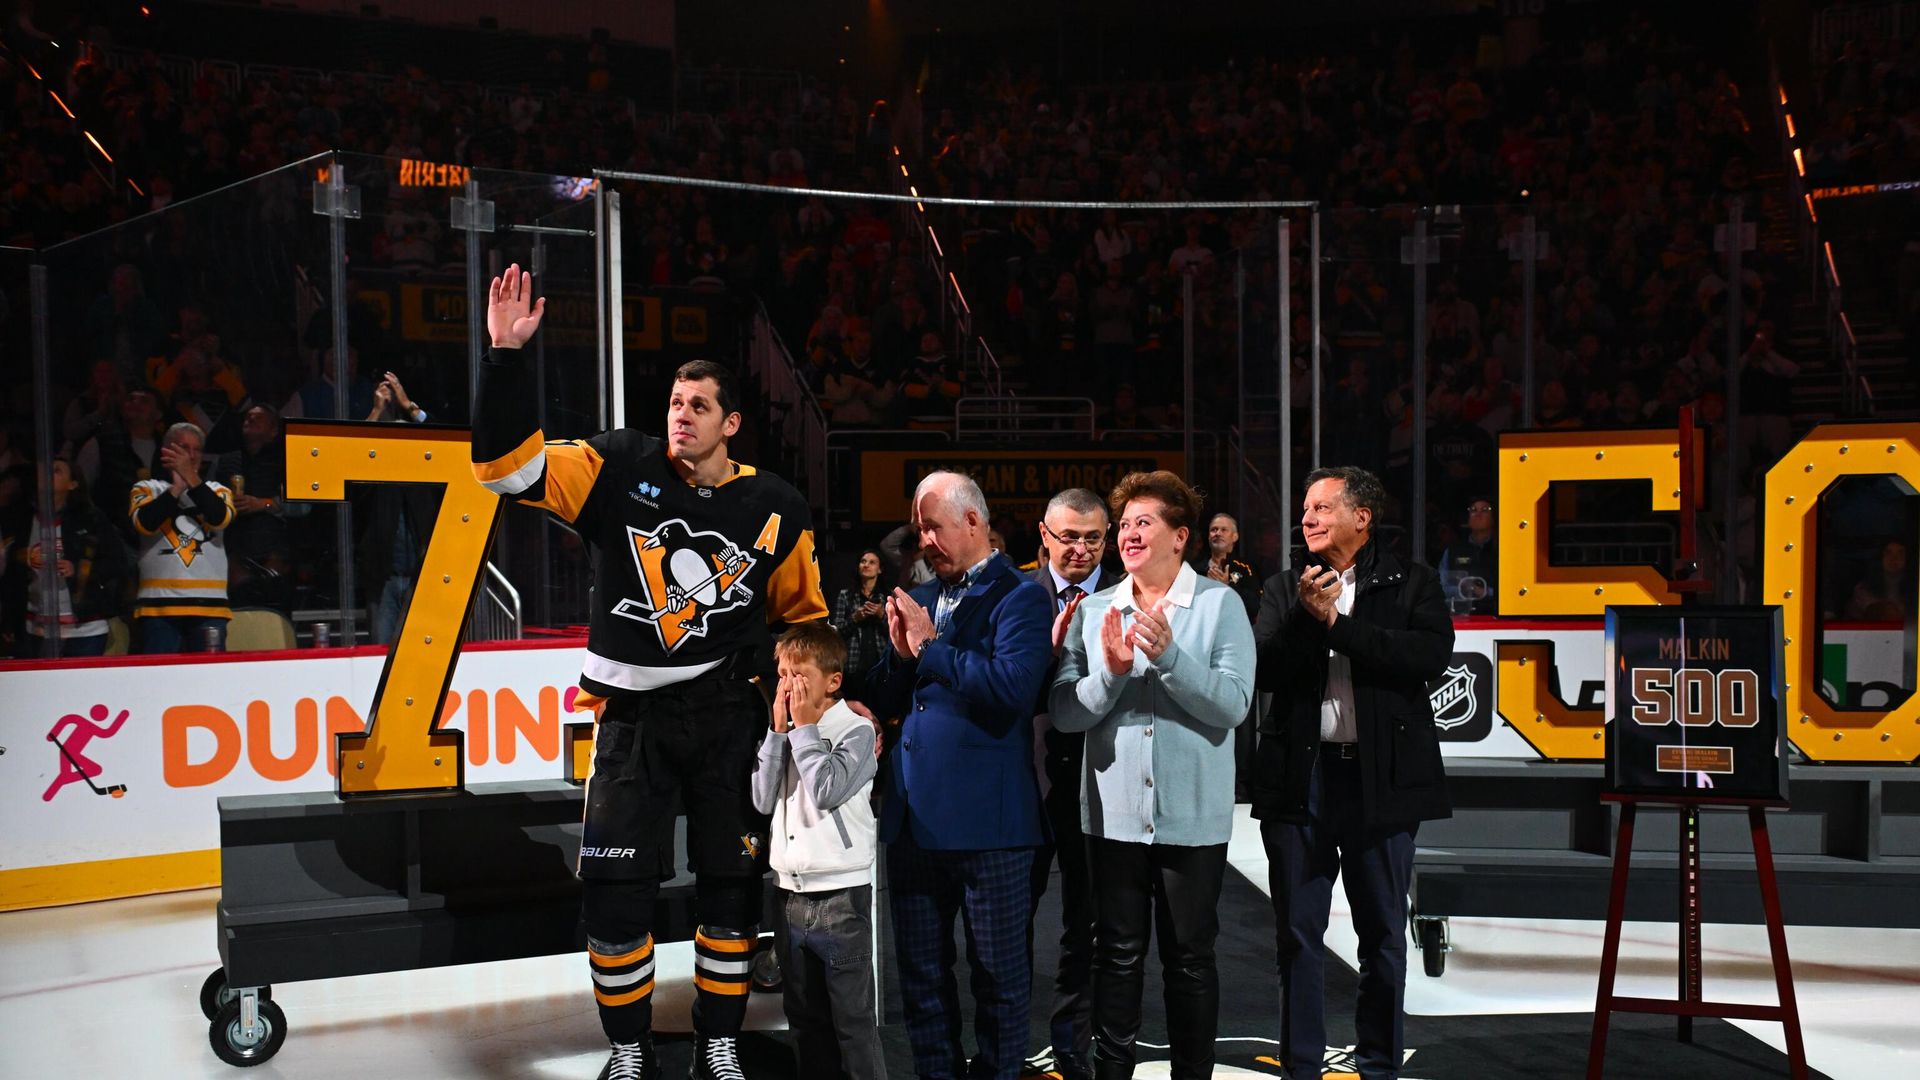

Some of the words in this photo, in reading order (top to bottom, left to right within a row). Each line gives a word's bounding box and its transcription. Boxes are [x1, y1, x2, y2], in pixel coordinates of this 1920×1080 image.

[916, 463, 1017, 493] MGAN
[1023, 463, 1040, 493] &
[1047, 463, 1145, 493] MORG
[753, 512, 782, 556] A
[1658, 637, 1731, 660] MALKIN
[1631, 667, 1760, 728] 500
[162, 686, 581, 788] DUNIN'
[580, 846, 637, 859] BAUER
